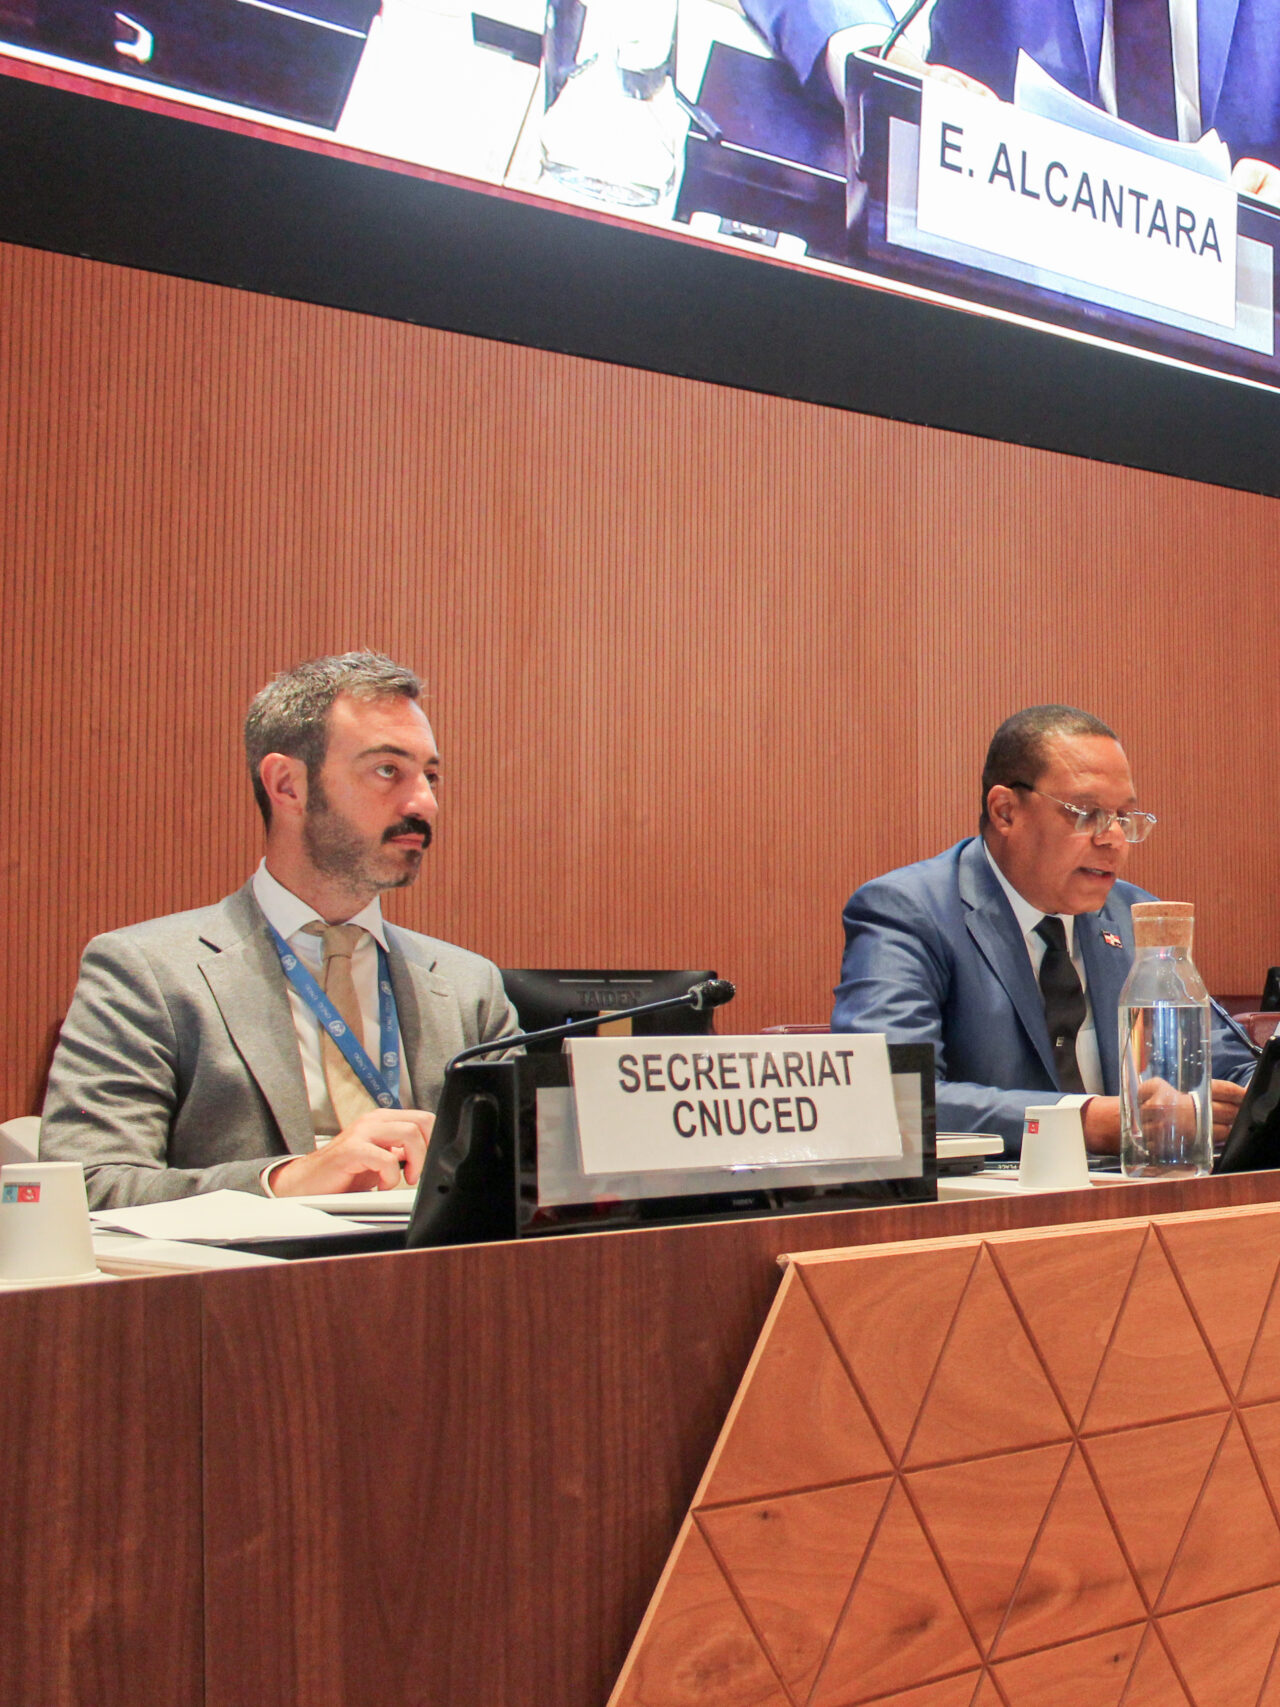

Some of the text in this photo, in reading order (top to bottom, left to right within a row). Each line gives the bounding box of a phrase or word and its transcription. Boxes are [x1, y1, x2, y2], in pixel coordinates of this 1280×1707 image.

[939, 120, 1223, 263] E. ALCANTARA
[618, 1050, 854, 1094] SECRETARIAT
[672, 1096, 818, 1139] CNUCED
